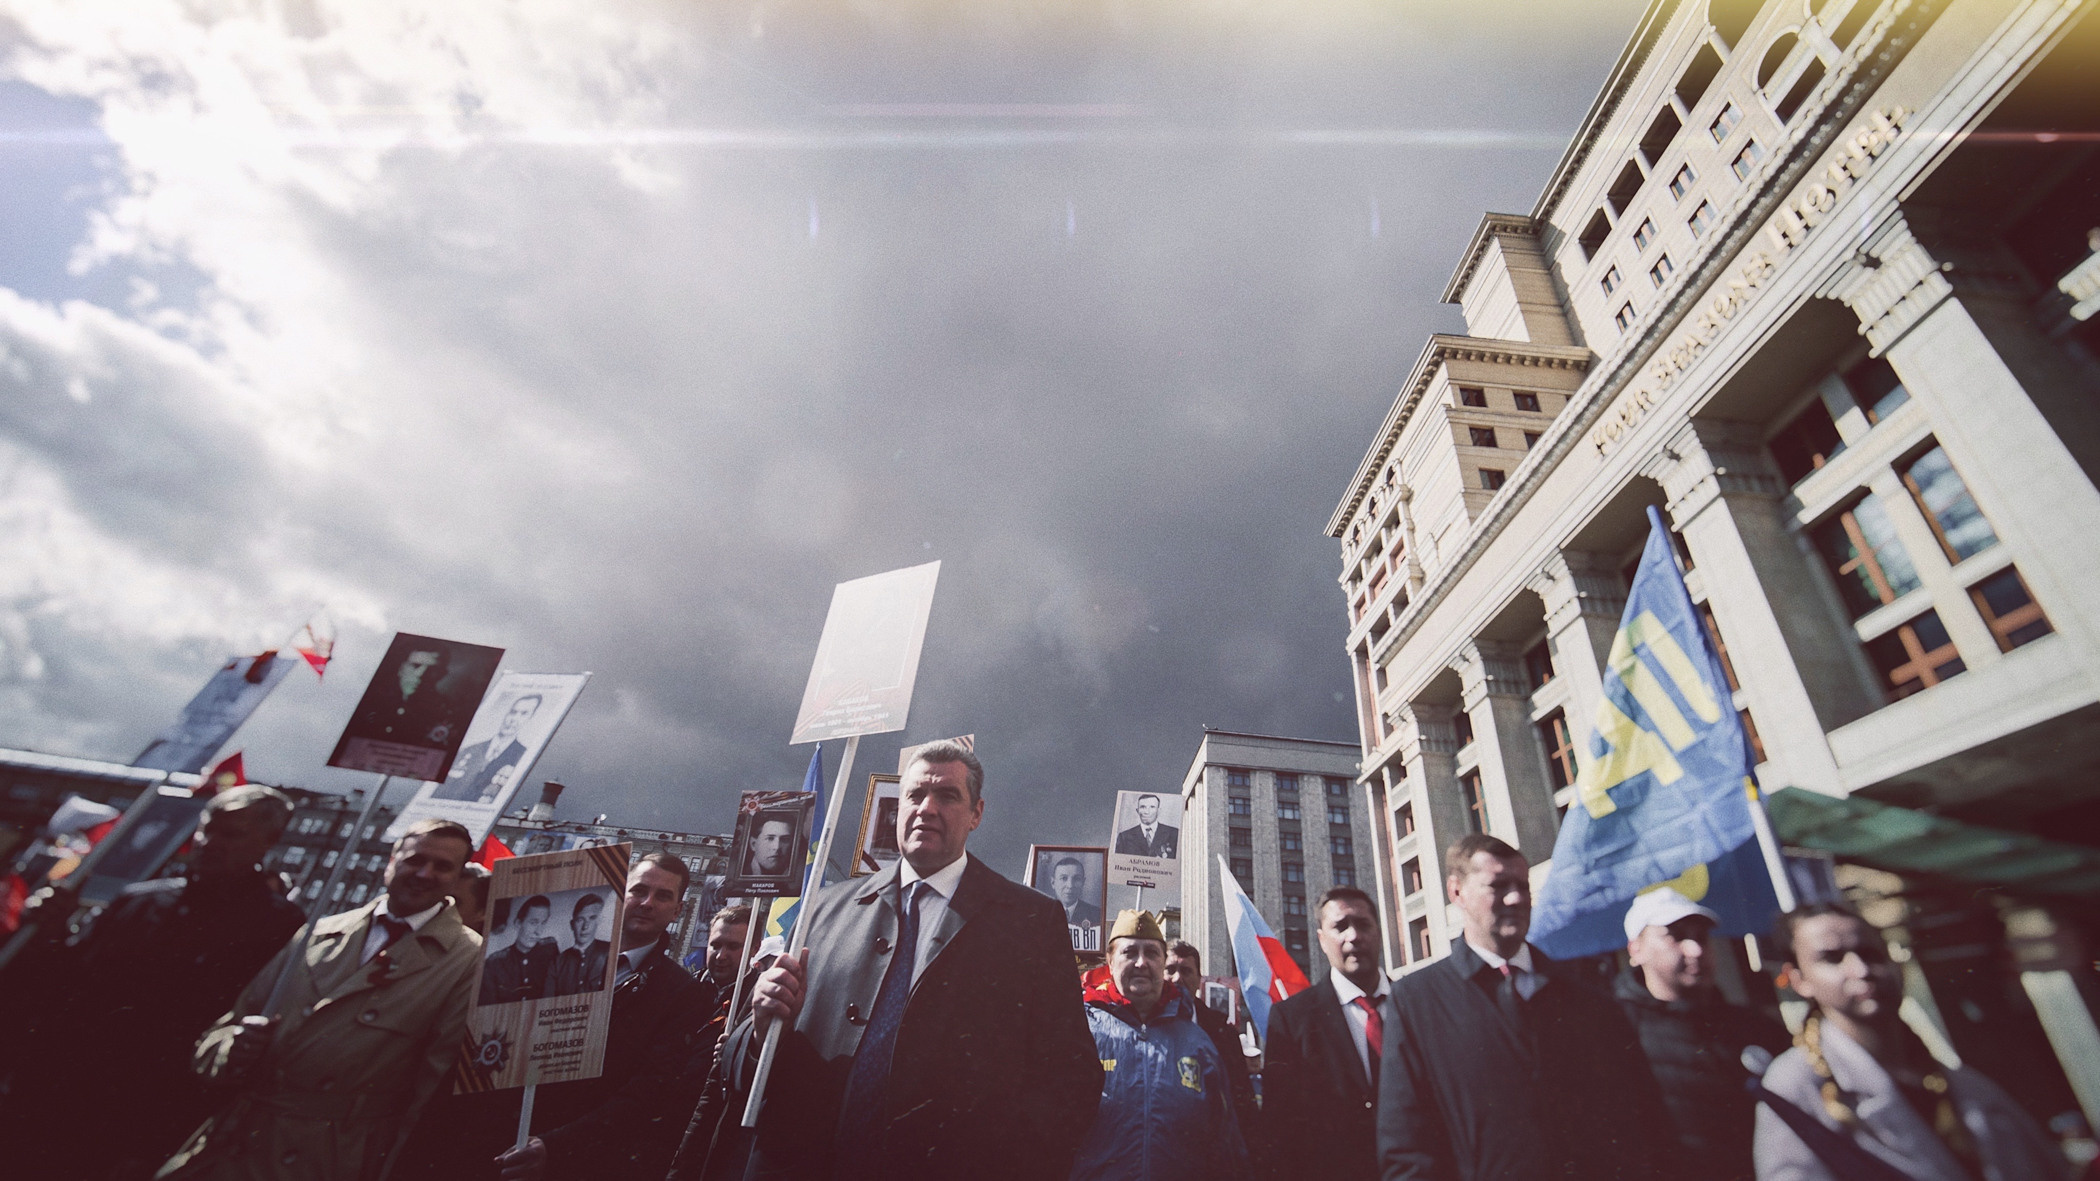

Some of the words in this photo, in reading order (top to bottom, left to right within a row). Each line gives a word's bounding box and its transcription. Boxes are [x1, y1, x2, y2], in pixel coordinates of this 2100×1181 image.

[1593, 388, 1656, 458] FOUR
[1650, 252, 1774, 392] SEASONS
[1766, 104, 1912, 254] HOTEL
[1129, 859, 1160, 867] АБРАМОВ
[539, 1005, 589, 1018] БОГОМАЗОВ
[533, 1039, 584, 1052] БОГОМАЗОВ
